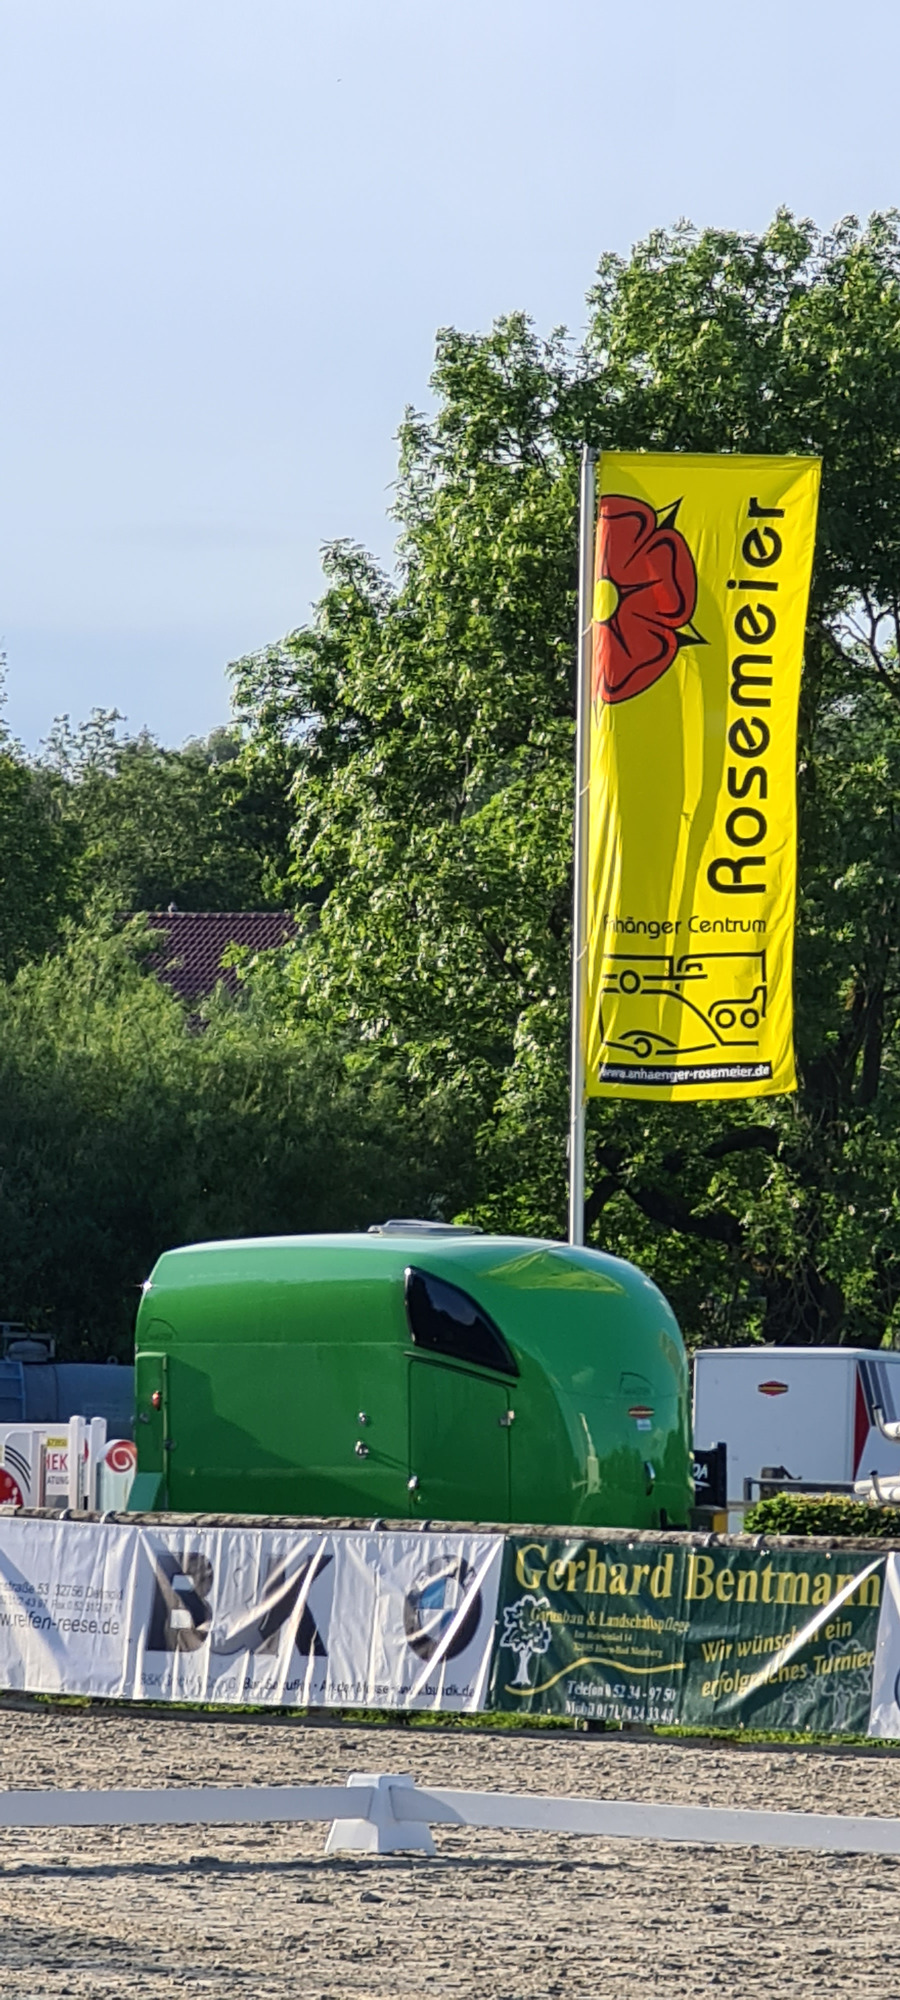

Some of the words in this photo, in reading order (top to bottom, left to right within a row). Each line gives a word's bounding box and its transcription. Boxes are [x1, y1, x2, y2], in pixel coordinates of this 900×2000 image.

[707, 497, 786, 895] Rosemeier
[688, 915, 767, 933] Centrum
[602, 1064, 769, 1083] www.anhaenger-rosemeier.de
[515, 1544, 673, 1598] Gerhard
[685, 1555, 881, 1606] Bentmann
[36, 1583, 50, 1596] 53
[586, 1611, 596, 1626] &
[599, 1611, 689, 1635] Landschaftspflege
[702, 1639, 733, 1663] Wir
[737, 1625, 819, 1658] wünschn
[825, 1616, 852, 1640] ein
[567, 1681, 603, 1697] Telefon
[613, 1685, 626, 1698] 52
[627, 1686, 641, 1700] 34
[648, 1687, 662, 1701] 97
[663, 1688, 676, 1702] 50
